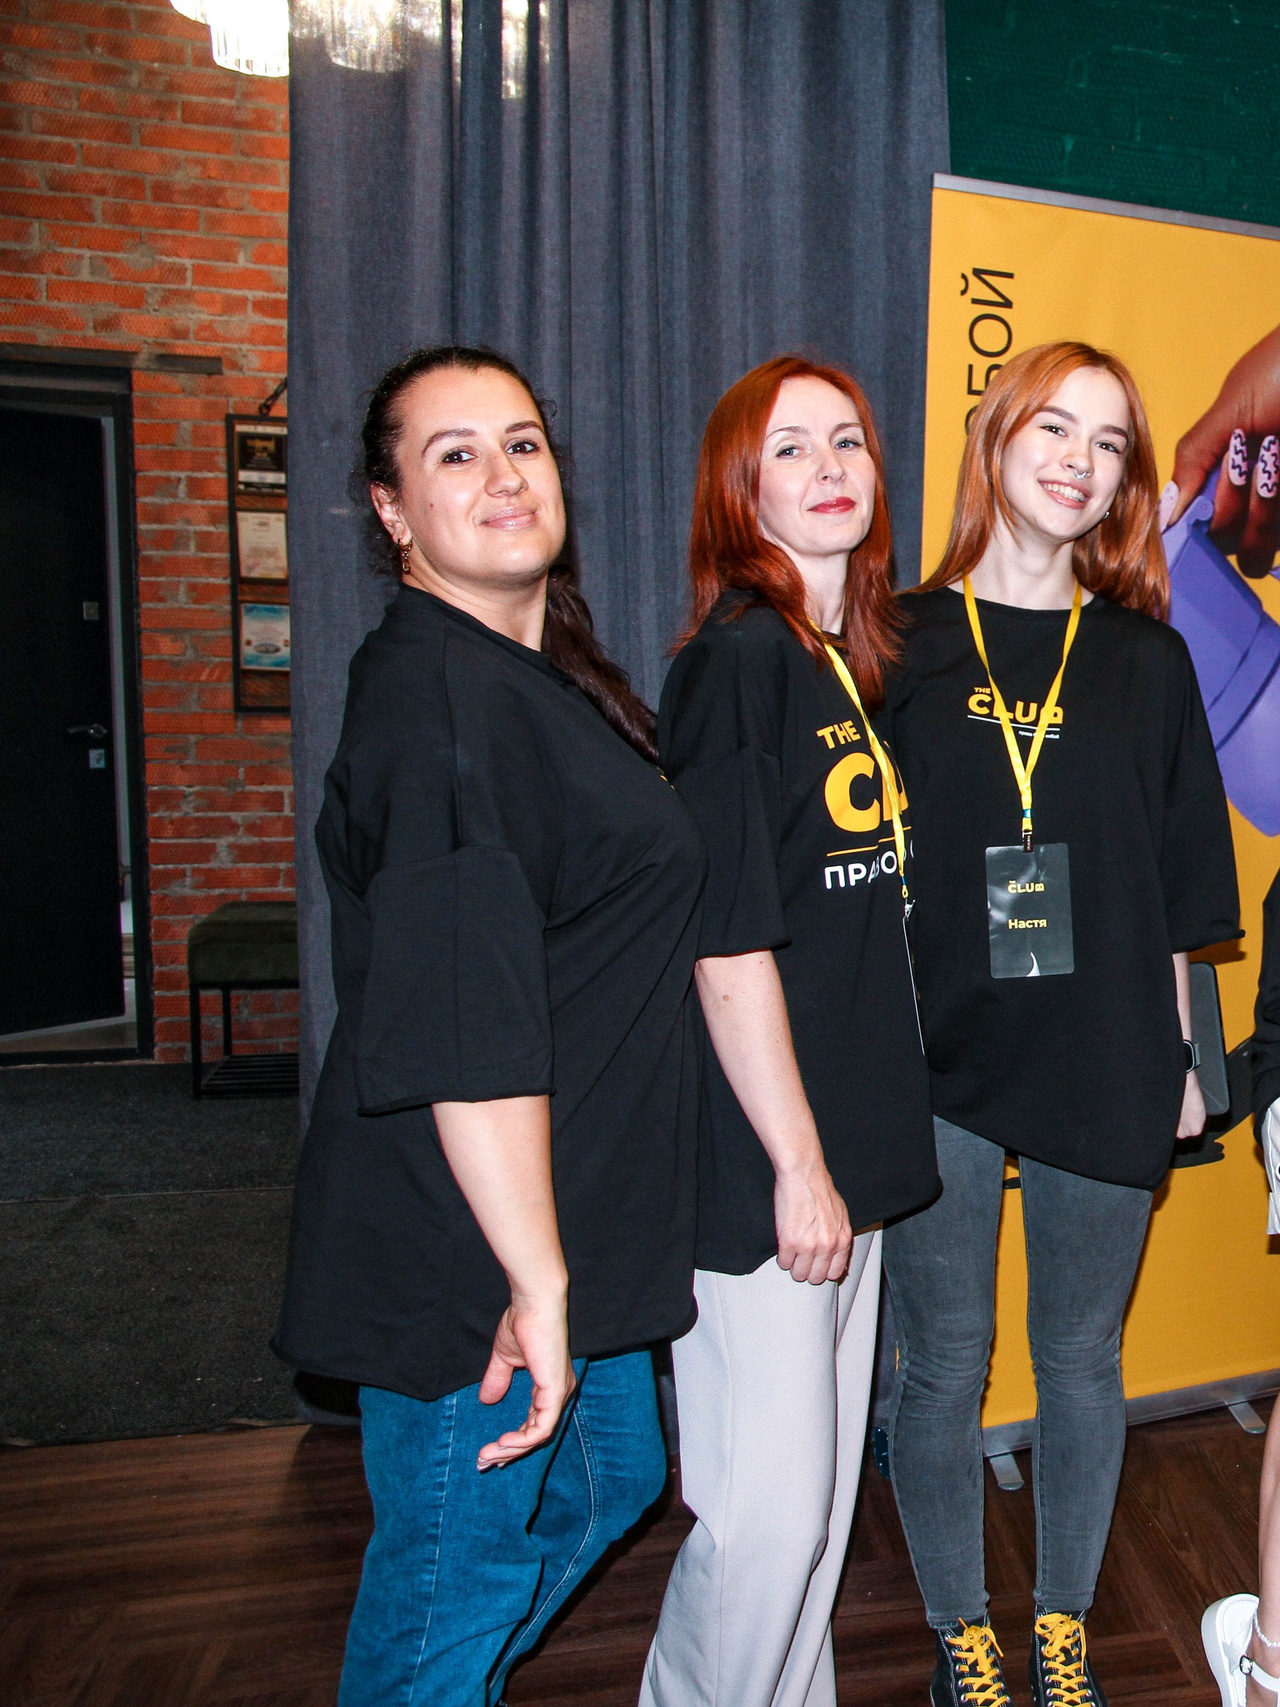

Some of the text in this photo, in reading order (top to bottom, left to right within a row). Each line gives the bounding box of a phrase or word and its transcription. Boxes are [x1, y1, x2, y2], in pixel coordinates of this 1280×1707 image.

[959, 266, 1016, 437] БОЙ
[816, 719, 862, 750] THE
[824, 739, 909, 833] CL
[1007, 882, 1045, 893] CLUB
[1008, 919, 1048, 929] Настя
